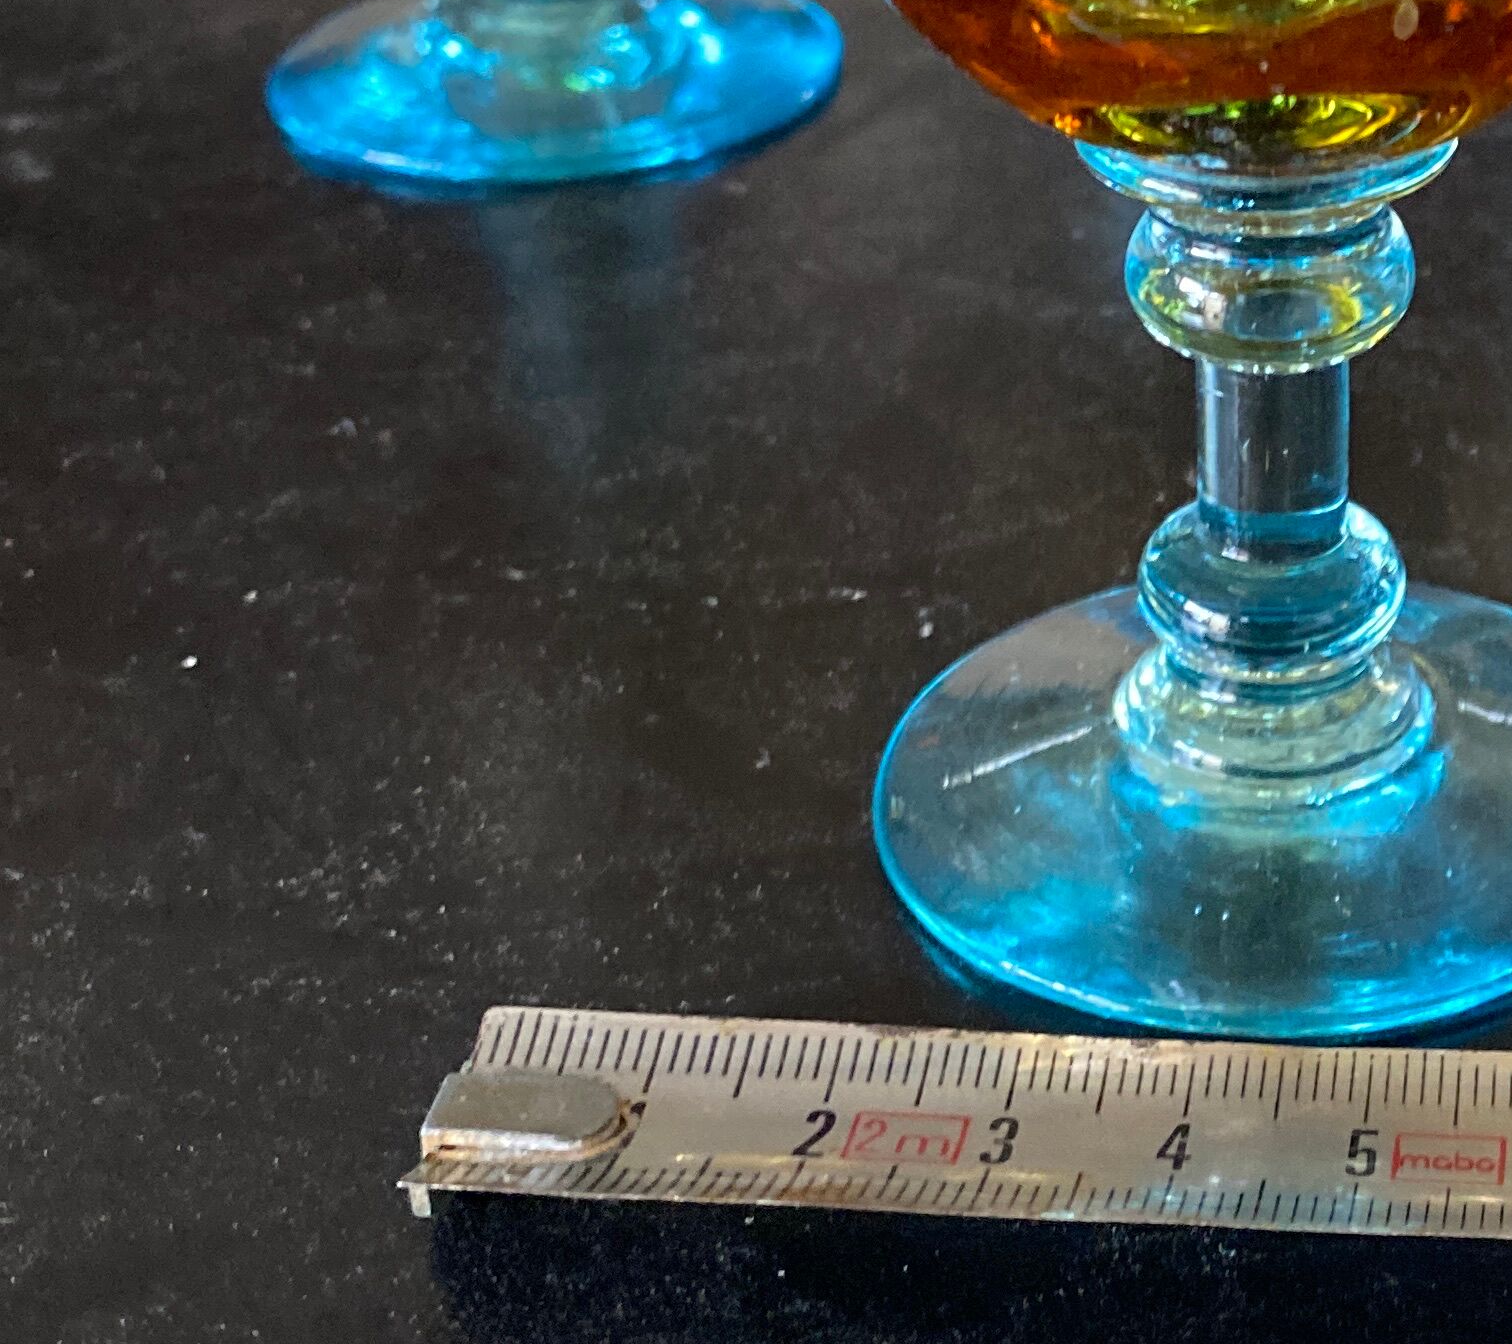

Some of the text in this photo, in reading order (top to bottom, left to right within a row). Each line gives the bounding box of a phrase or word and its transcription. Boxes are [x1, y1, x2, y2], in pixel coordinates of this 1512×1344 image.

[792, 1109, 838, 1158] 2
[978, 1116, 1020, 1165] 3
[1155, 1122, 1193, 1171] 4
[1344, 1128, 1380, 1177] 5
